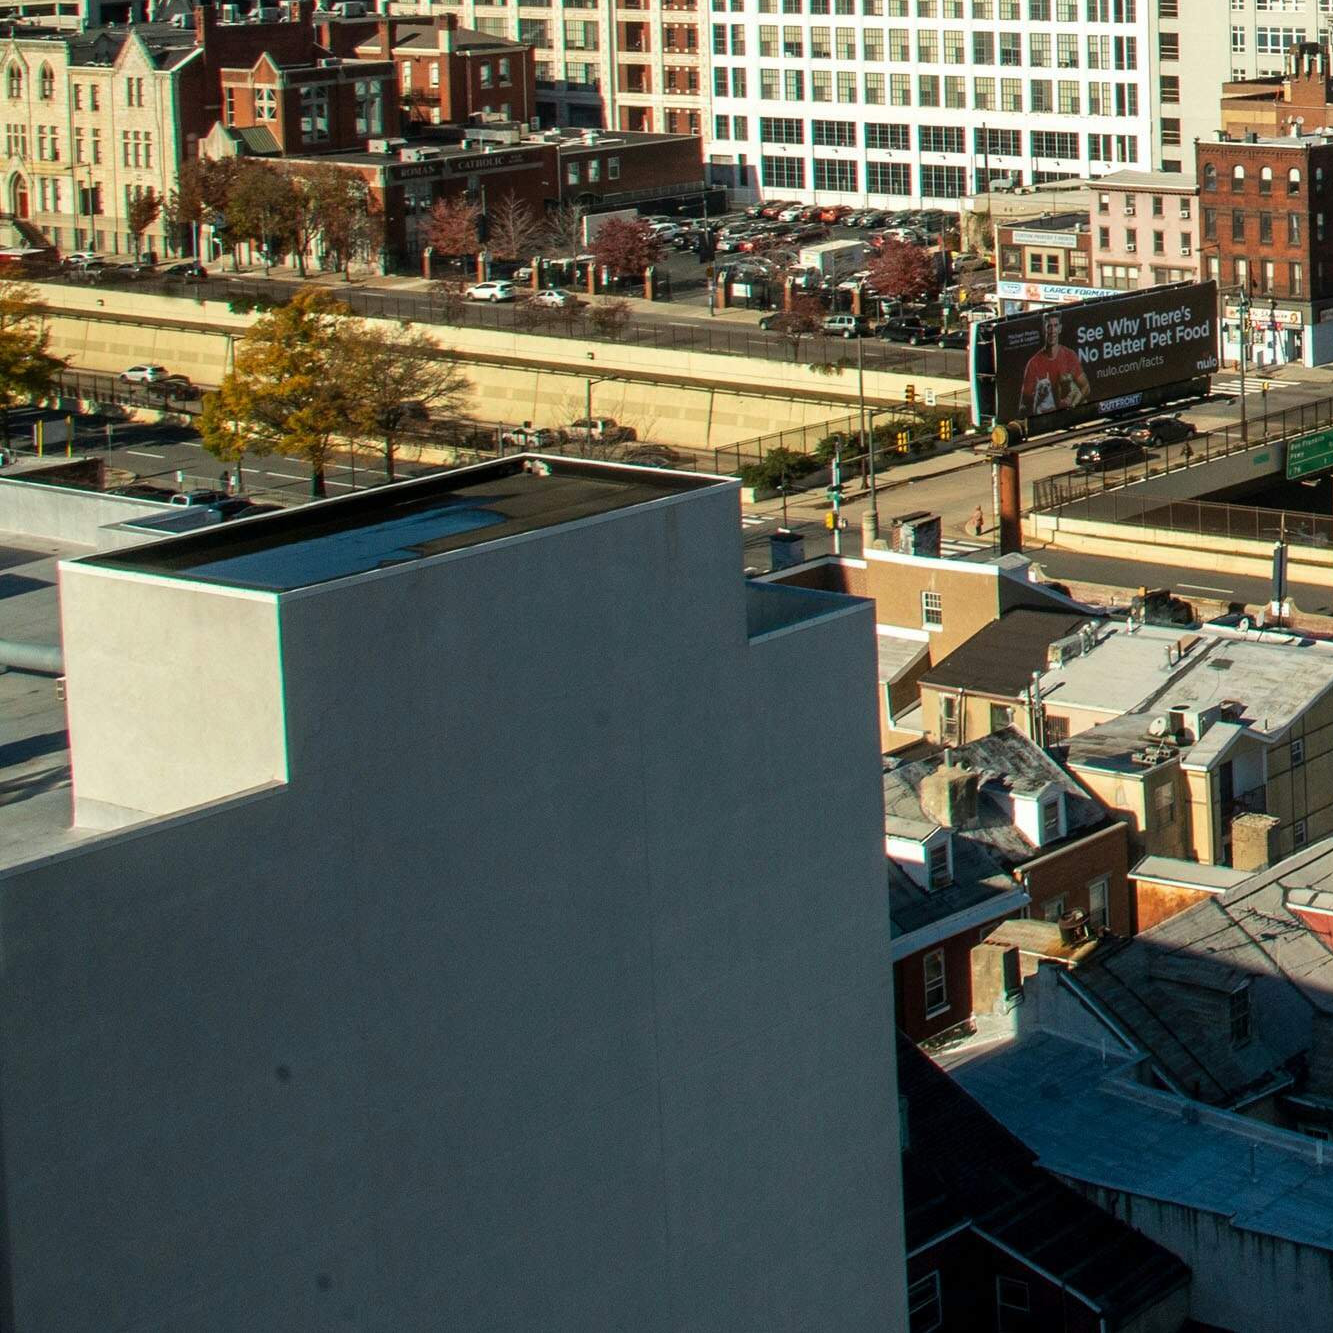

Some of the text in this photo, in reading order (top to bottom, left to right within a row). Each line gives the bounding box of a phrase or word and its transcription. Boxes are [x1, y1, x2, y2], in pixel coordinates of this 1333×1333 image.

[401, 165, 435, 177] ROMAN
[458, 157, 504, 170] CATHOLIC
[1044, 286, 1074, 295] LARGE
[1075, 288, 1111, 297] FORMAT
[1077, 305, 1192, 343] See Why There's
[1077, 320, 1210, 363] No Better Pet Food
[1097, 354, 1165, 379] nulo.com/facts
[1196, 355, 1218, 370] nulo
